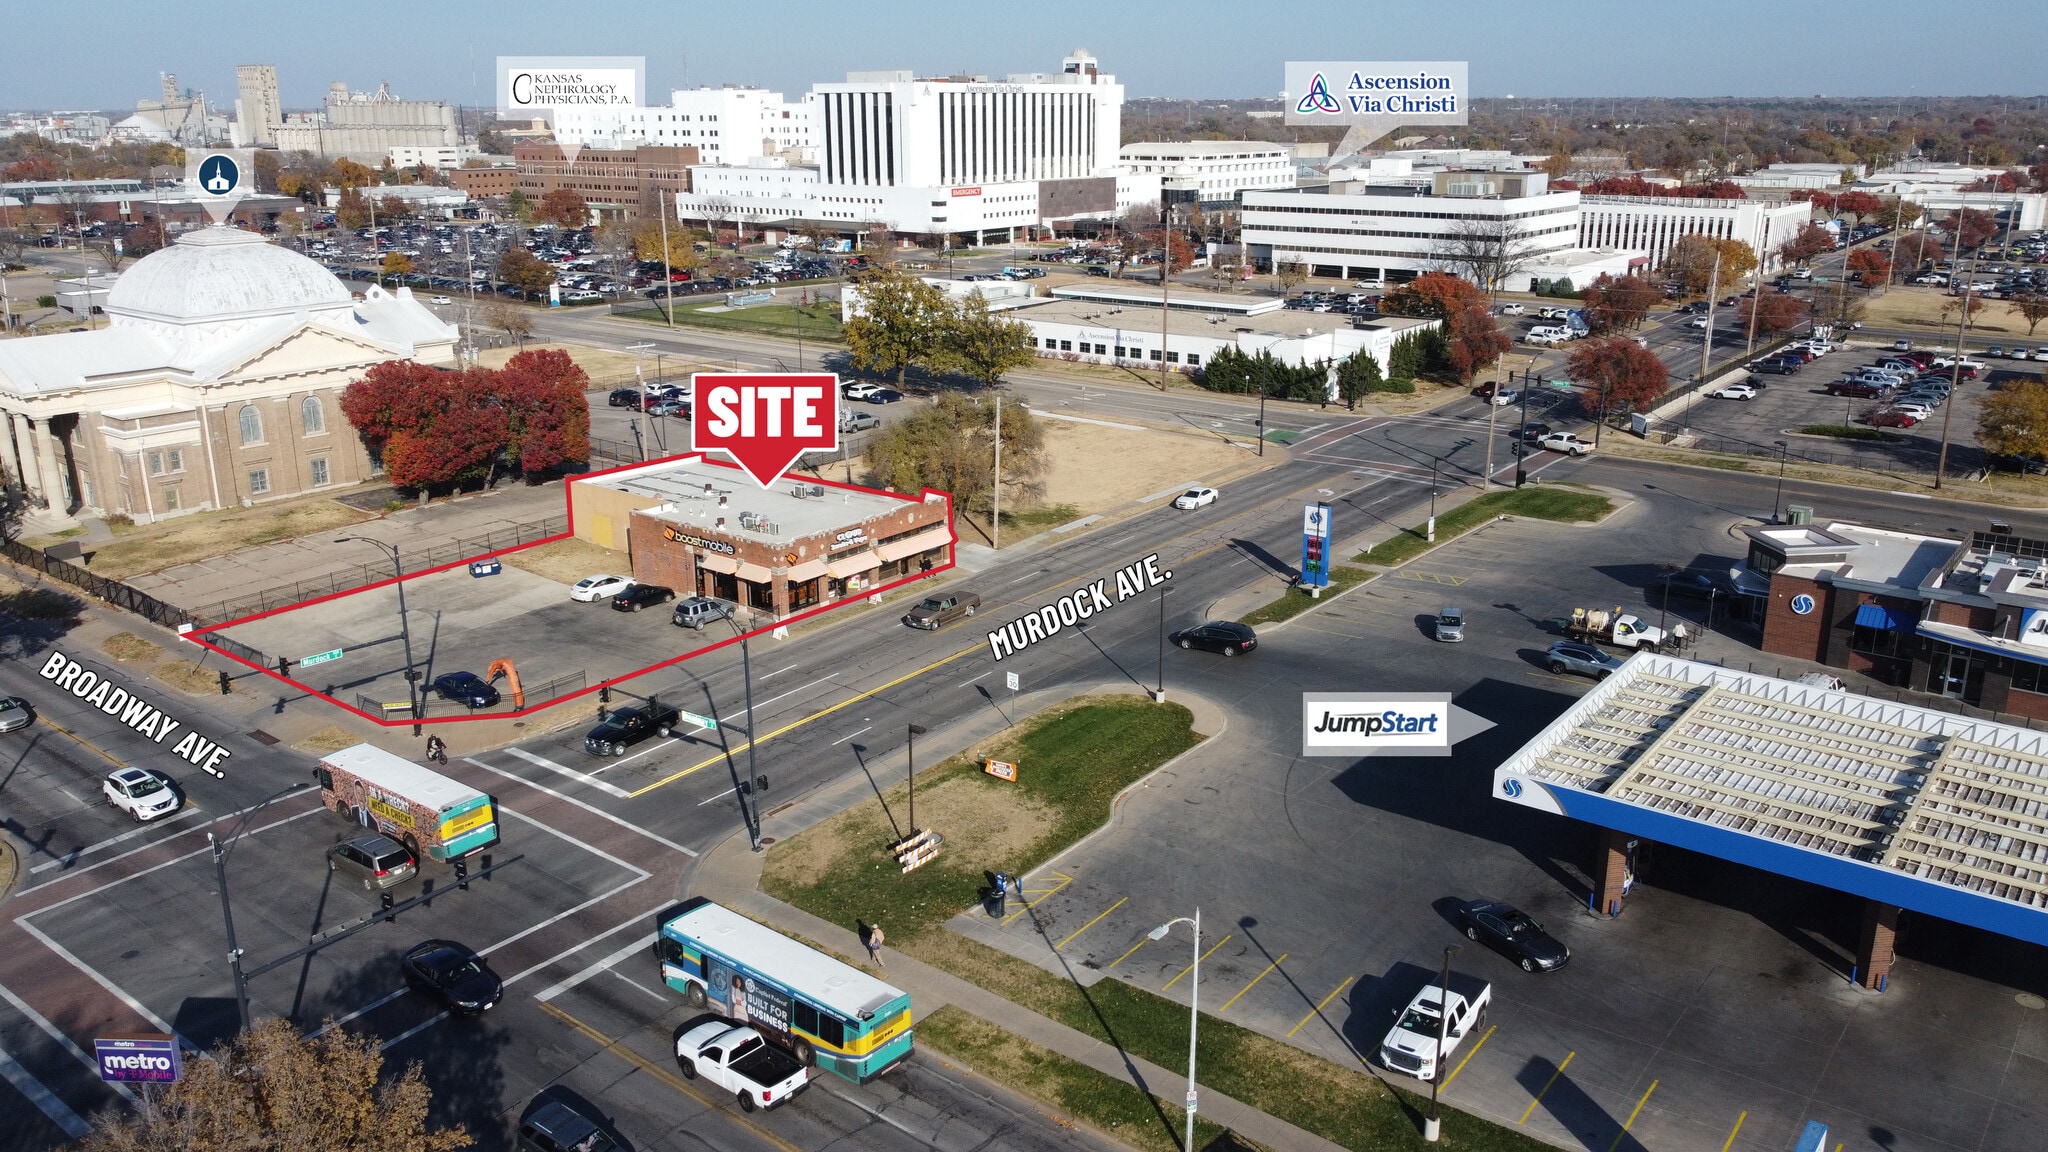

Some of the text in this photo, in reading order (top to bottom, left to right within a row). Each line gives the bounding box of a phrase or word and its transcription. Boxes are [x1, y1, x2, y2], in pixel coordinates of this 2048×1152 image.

[965, 84, 1025, 93] Ascension Via Christi
[1088, 332, 1115, 341] Ascension
[1125, 335, 1144, 344] Christi
[371, 801, 385, 814] NEED
[385, 806, 391, 817] A
[390, 808, 413, 827] CHECK?
[755, 986, 788, 1007] Capitol Federal
[747, 993, 788, 1020] BUILT FOR
[747, 1004, 788, 1033] BUSINESS
[104, 1053, 171, 1071] metro
[115, 1070, 126, 1079] by
